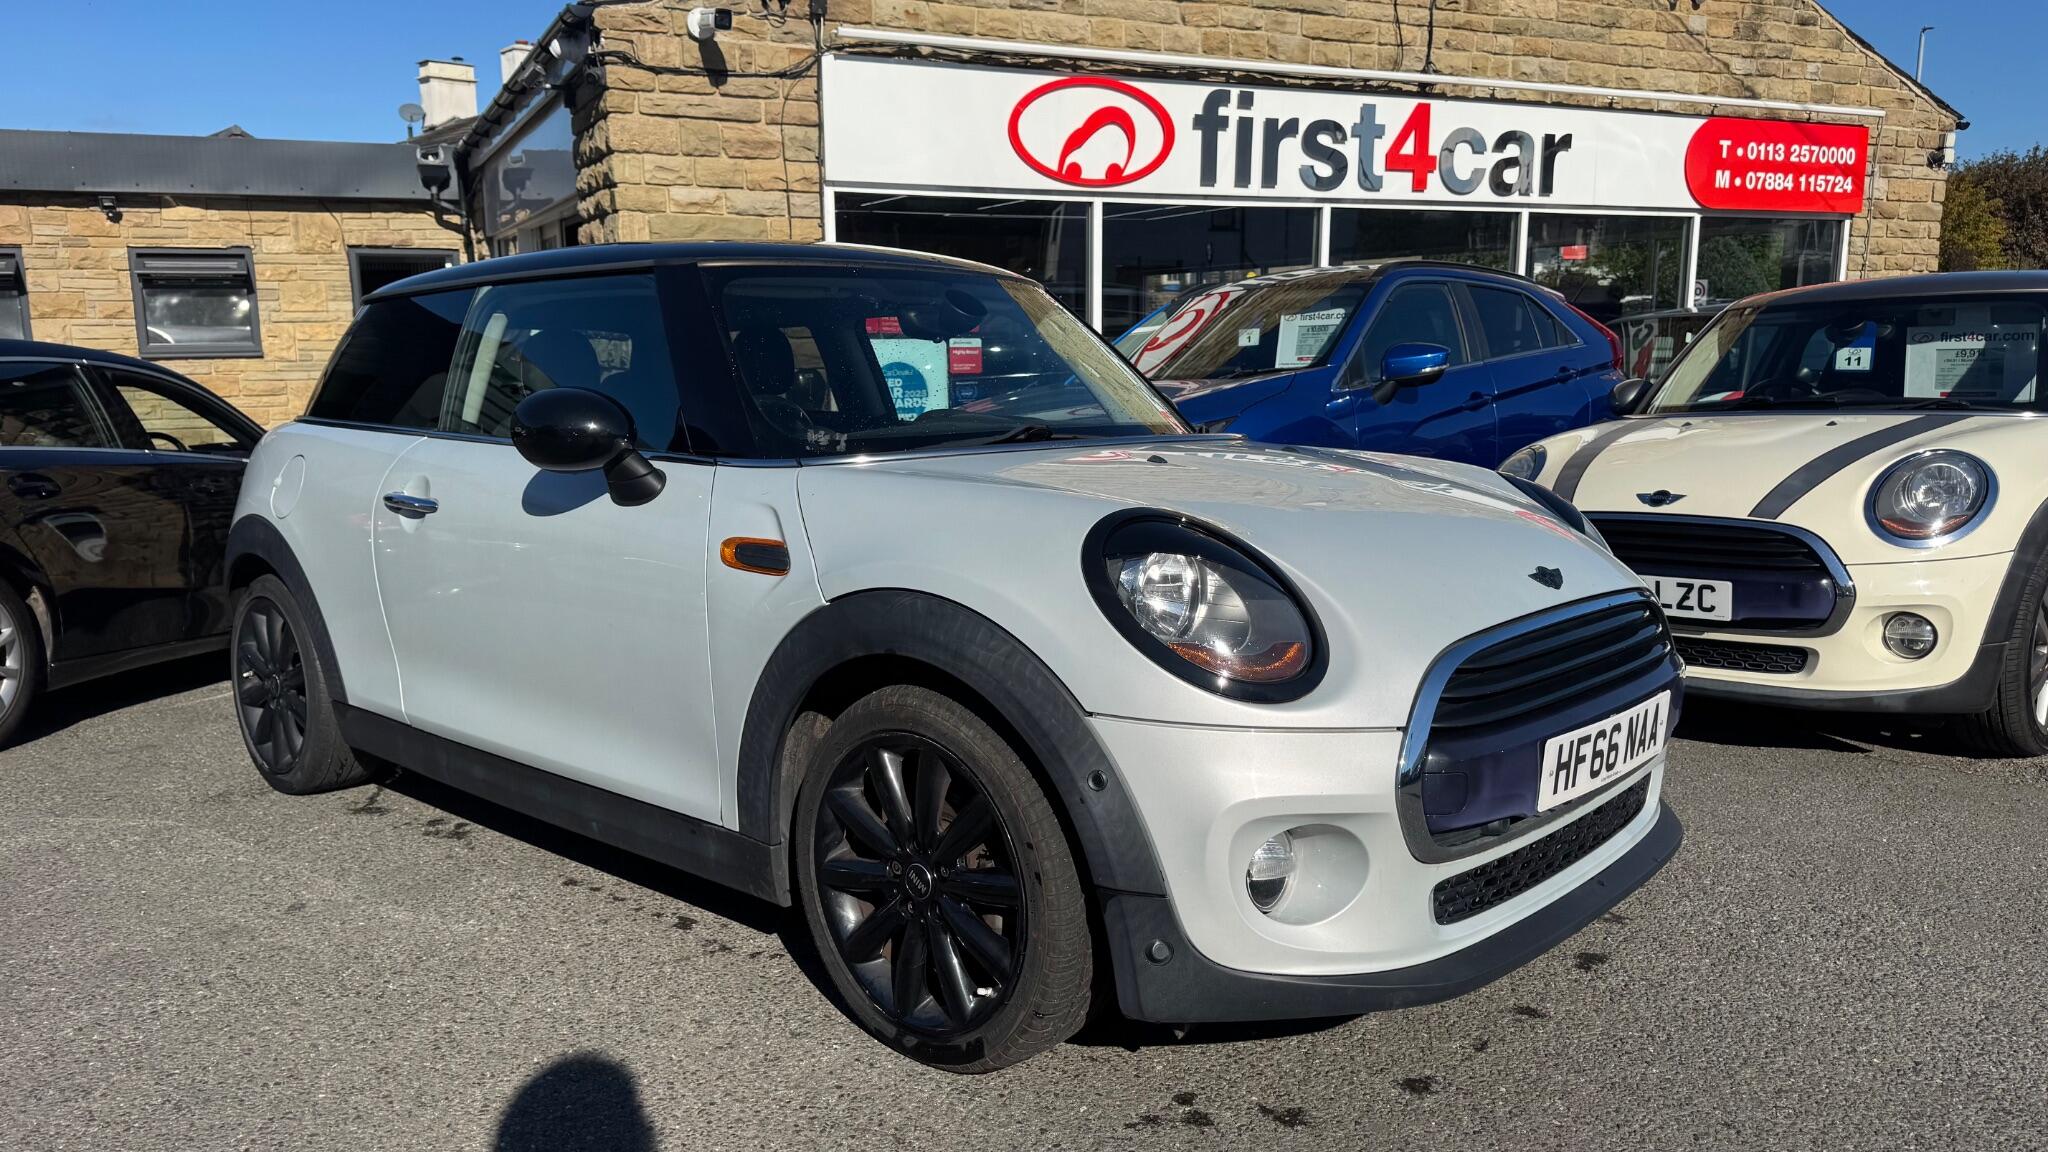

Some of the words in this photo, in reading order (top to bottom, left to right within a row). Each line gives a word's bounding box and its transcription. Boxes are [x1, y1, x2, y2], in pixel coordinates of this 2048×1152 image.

[1192, 89, 1573, 197] first4car
[1719, 140, 1732, 158] T
[1747, 142, 1785, 162] 0113
[1790, 144, 1856, 165] 2570000
[1715, 169, 1731, 189] M
[1745, 171, 1794, 191] 07884
[1799, 174, 1853, 193] 115724
[1300, 312, 1346, 321] first4car.co
[1844, 356, 1861, 366] 11
[1655, 580, 1717, 613] LZC
[1553, 722, 1622, 796] HF66
[1623, 702, 1660, 765] NAA
